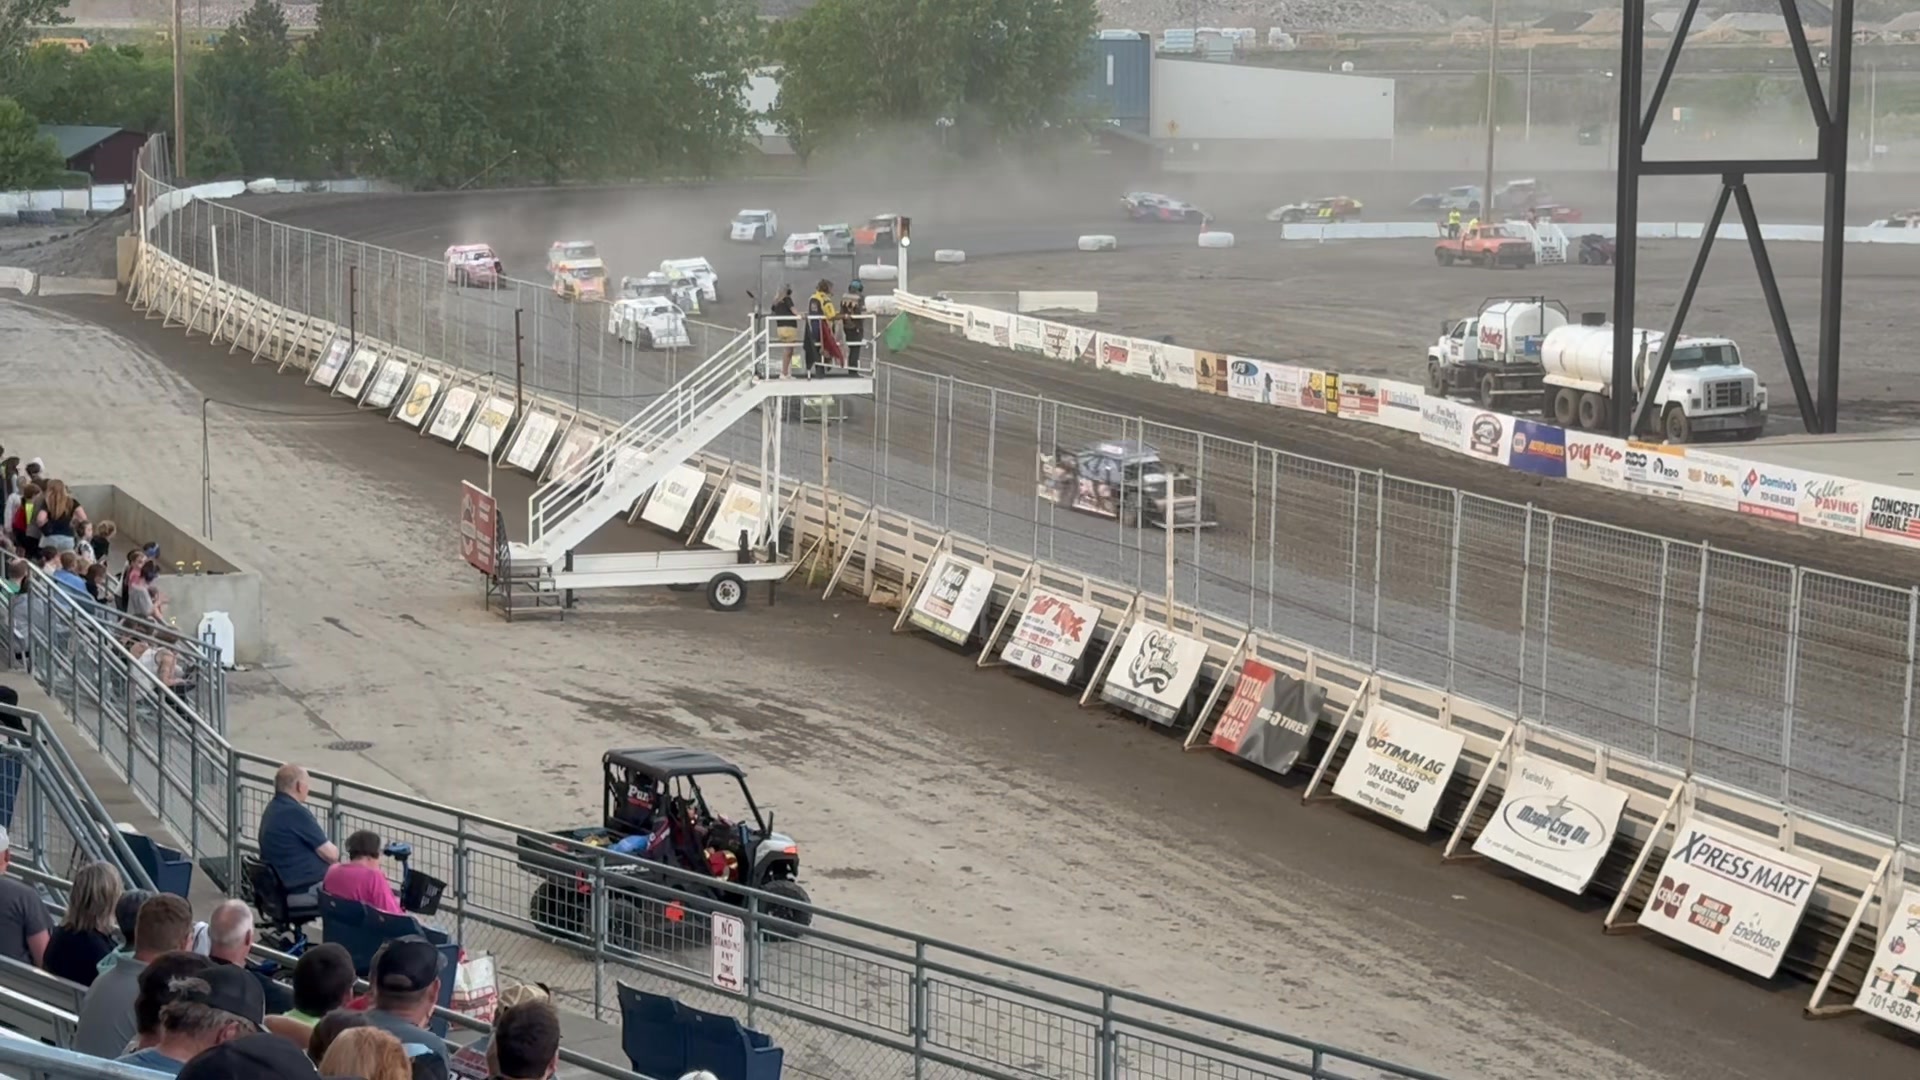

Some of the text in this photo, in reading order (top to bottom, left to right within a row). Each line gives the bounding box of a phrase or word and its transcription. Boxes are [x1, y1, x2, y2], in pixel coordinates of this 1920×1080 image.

[1568, 443, 1591, 461] Dig
[1760, 474, 1797, 492] Domino's
[1814, 496, 1859, 515] PAVING
[1868, 512, 1909, 533] MOBILE
[1240, 673, 1266, 702] TOTAL
[1223, 696, 1256, 721] AUTO
[1214, 715, 1245, 742] CARE
[1280, 715, 1309, 736] TIRES
[1366, 736, 1446, 775] OPTIMUM AG
[1396, 764, 1437, 785] SOLUTIONS
[1521, 768, 1544, 785] Fueled
[1672, 830, 1810, 900] XPRESS MART
[1657, 887, 1685, 908] CENEX
[721, 922, 733, 937] NO
[1732, 921, 1781, 952] Enerbase
[714, 936, 740, 952] STANDING
[721, 951, 734, 960] ANY
